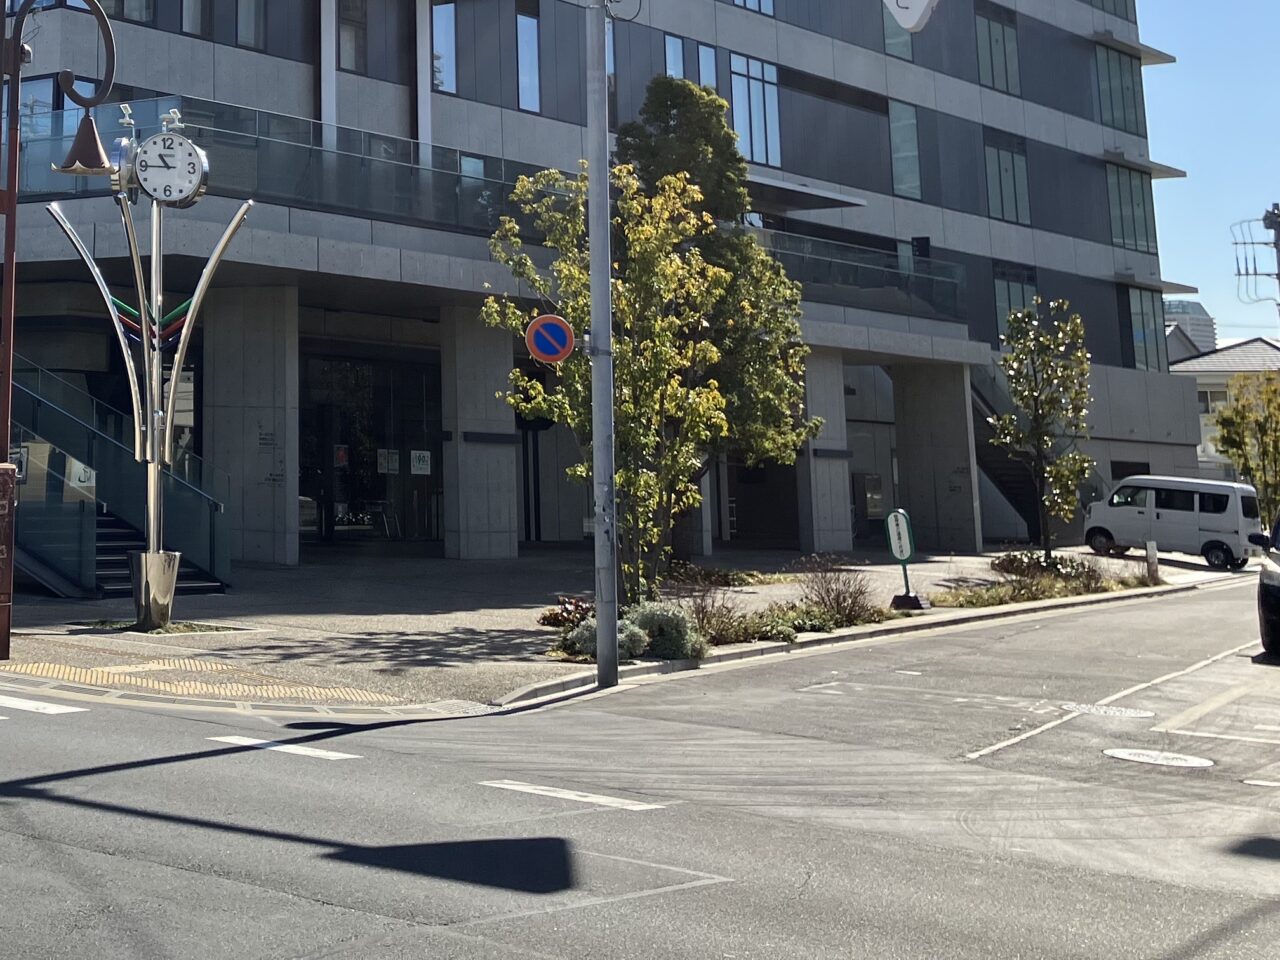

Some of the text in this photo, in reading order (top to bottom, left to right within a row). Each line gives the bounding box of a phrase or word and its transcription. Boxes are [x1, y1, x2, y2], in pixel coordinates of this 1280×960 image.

[161, 137, 175, 150] 12
[139, 159, 148, 172] 9
[187, 162, 196, 175] 3
[163, 184, 172, 198] 6
